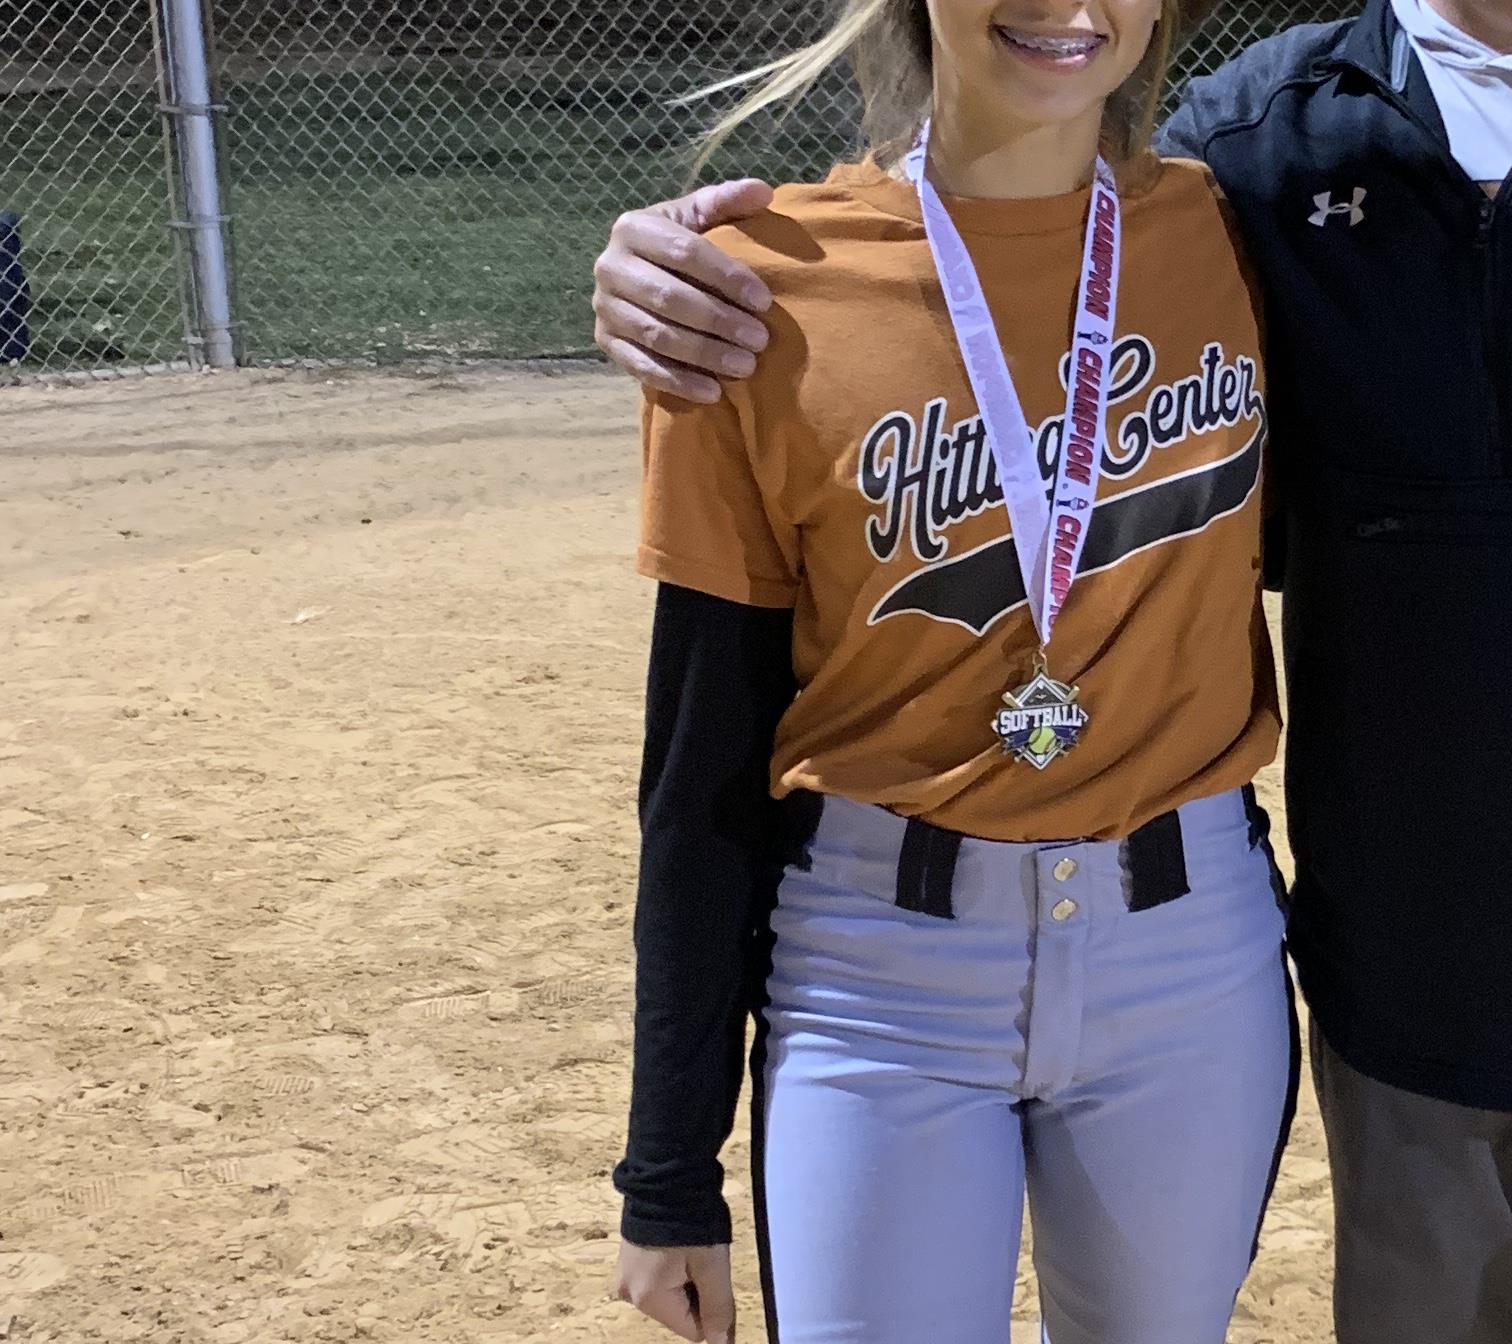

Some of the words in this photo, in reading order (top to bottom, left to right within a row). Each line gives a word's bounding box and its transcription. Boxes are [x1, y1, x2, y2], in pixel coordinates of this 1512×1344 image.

[1084, 190, 1116, 322] CHAMPION
[859, 397, 1068, 563] Hittig
[1059, 334, 1262, 480] Center
[1064, 347, 1103, 486] CHAMPION
[1048, 514, 1082, 634] CHAMP
[1000, 704, 1082, 735] SOFTBALL
